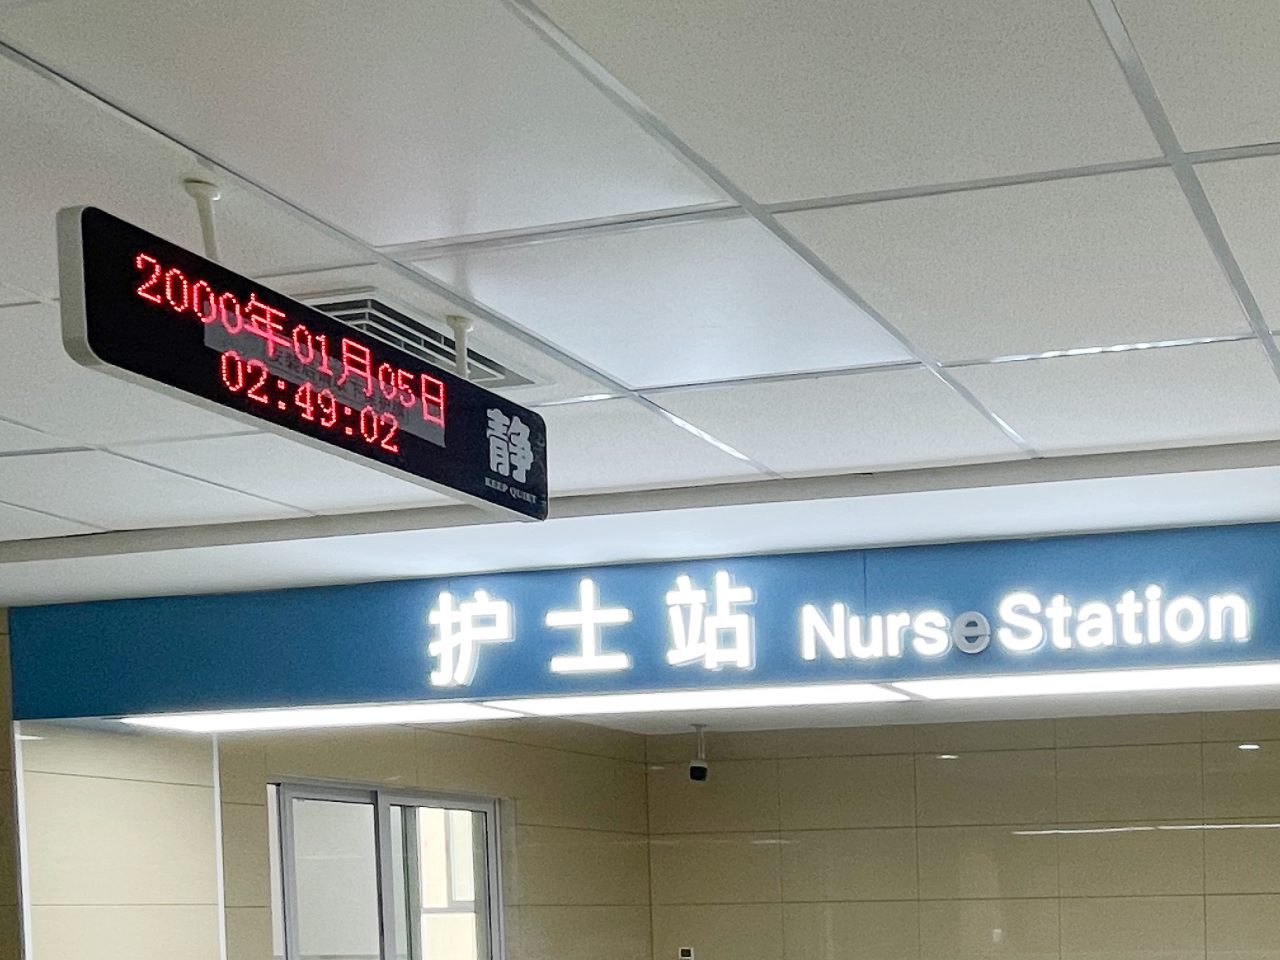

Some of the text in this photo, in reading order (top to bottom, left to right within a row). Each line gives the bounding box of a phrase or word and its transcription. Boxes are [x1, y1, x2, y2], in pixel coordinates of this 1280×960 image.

[136, 253, 445, 428] 2000年01月05日
[220, 350, 399, 453] 02:49:02
[486, 408, 534, 483] 静
[484, 477, 538, 504] KEEP QUIET
[428, 570, 756, 686] 护士站
[800, 584, 1248, 660] Nurse Station
